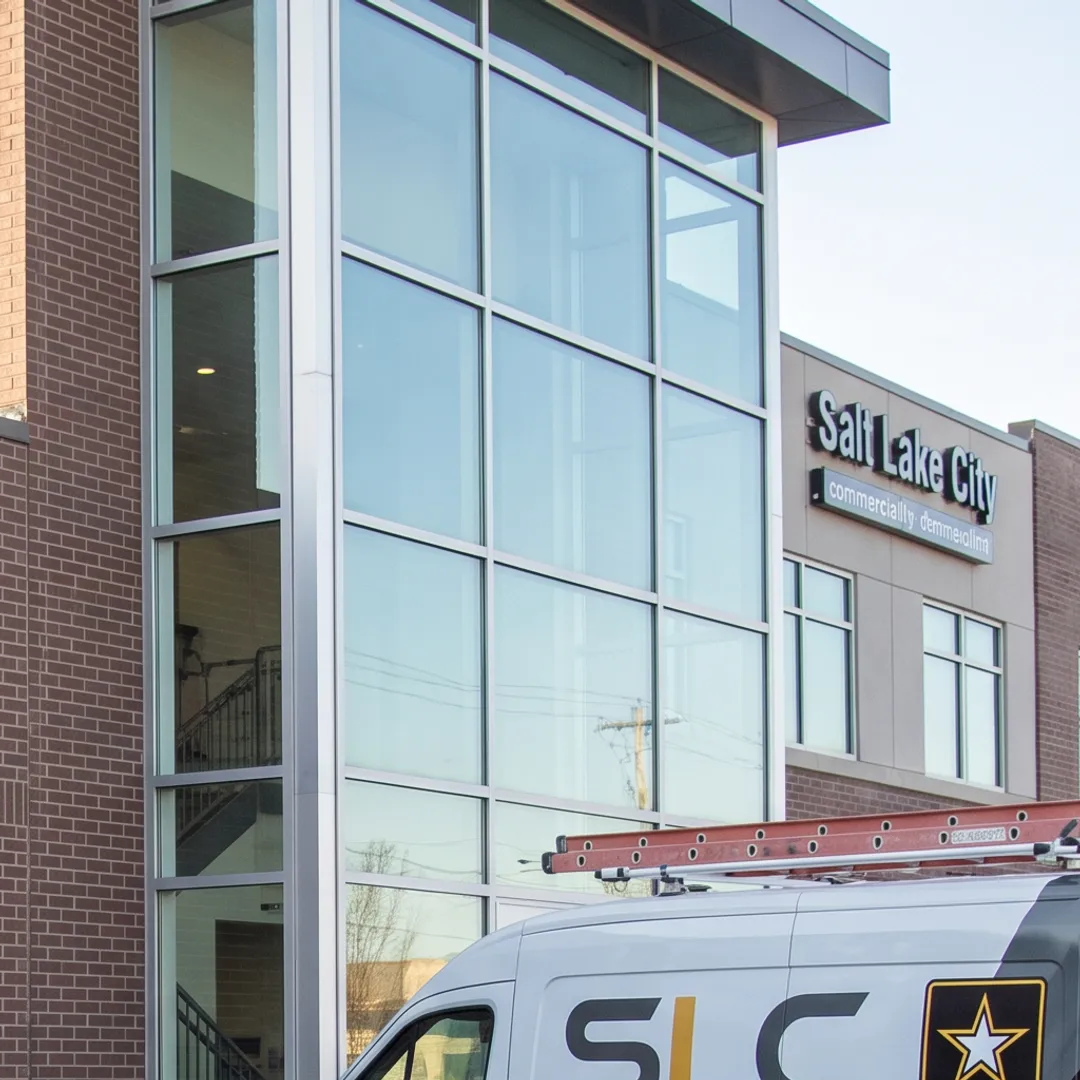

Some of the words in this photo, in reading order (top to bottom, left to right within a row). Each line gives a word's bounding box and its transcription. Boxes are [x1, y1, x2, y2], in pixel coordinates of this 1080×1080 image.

[810, 389, 874, 467] Salt
[875, 414, 944, 494] Lake
[948, 444, 998, 525] City
